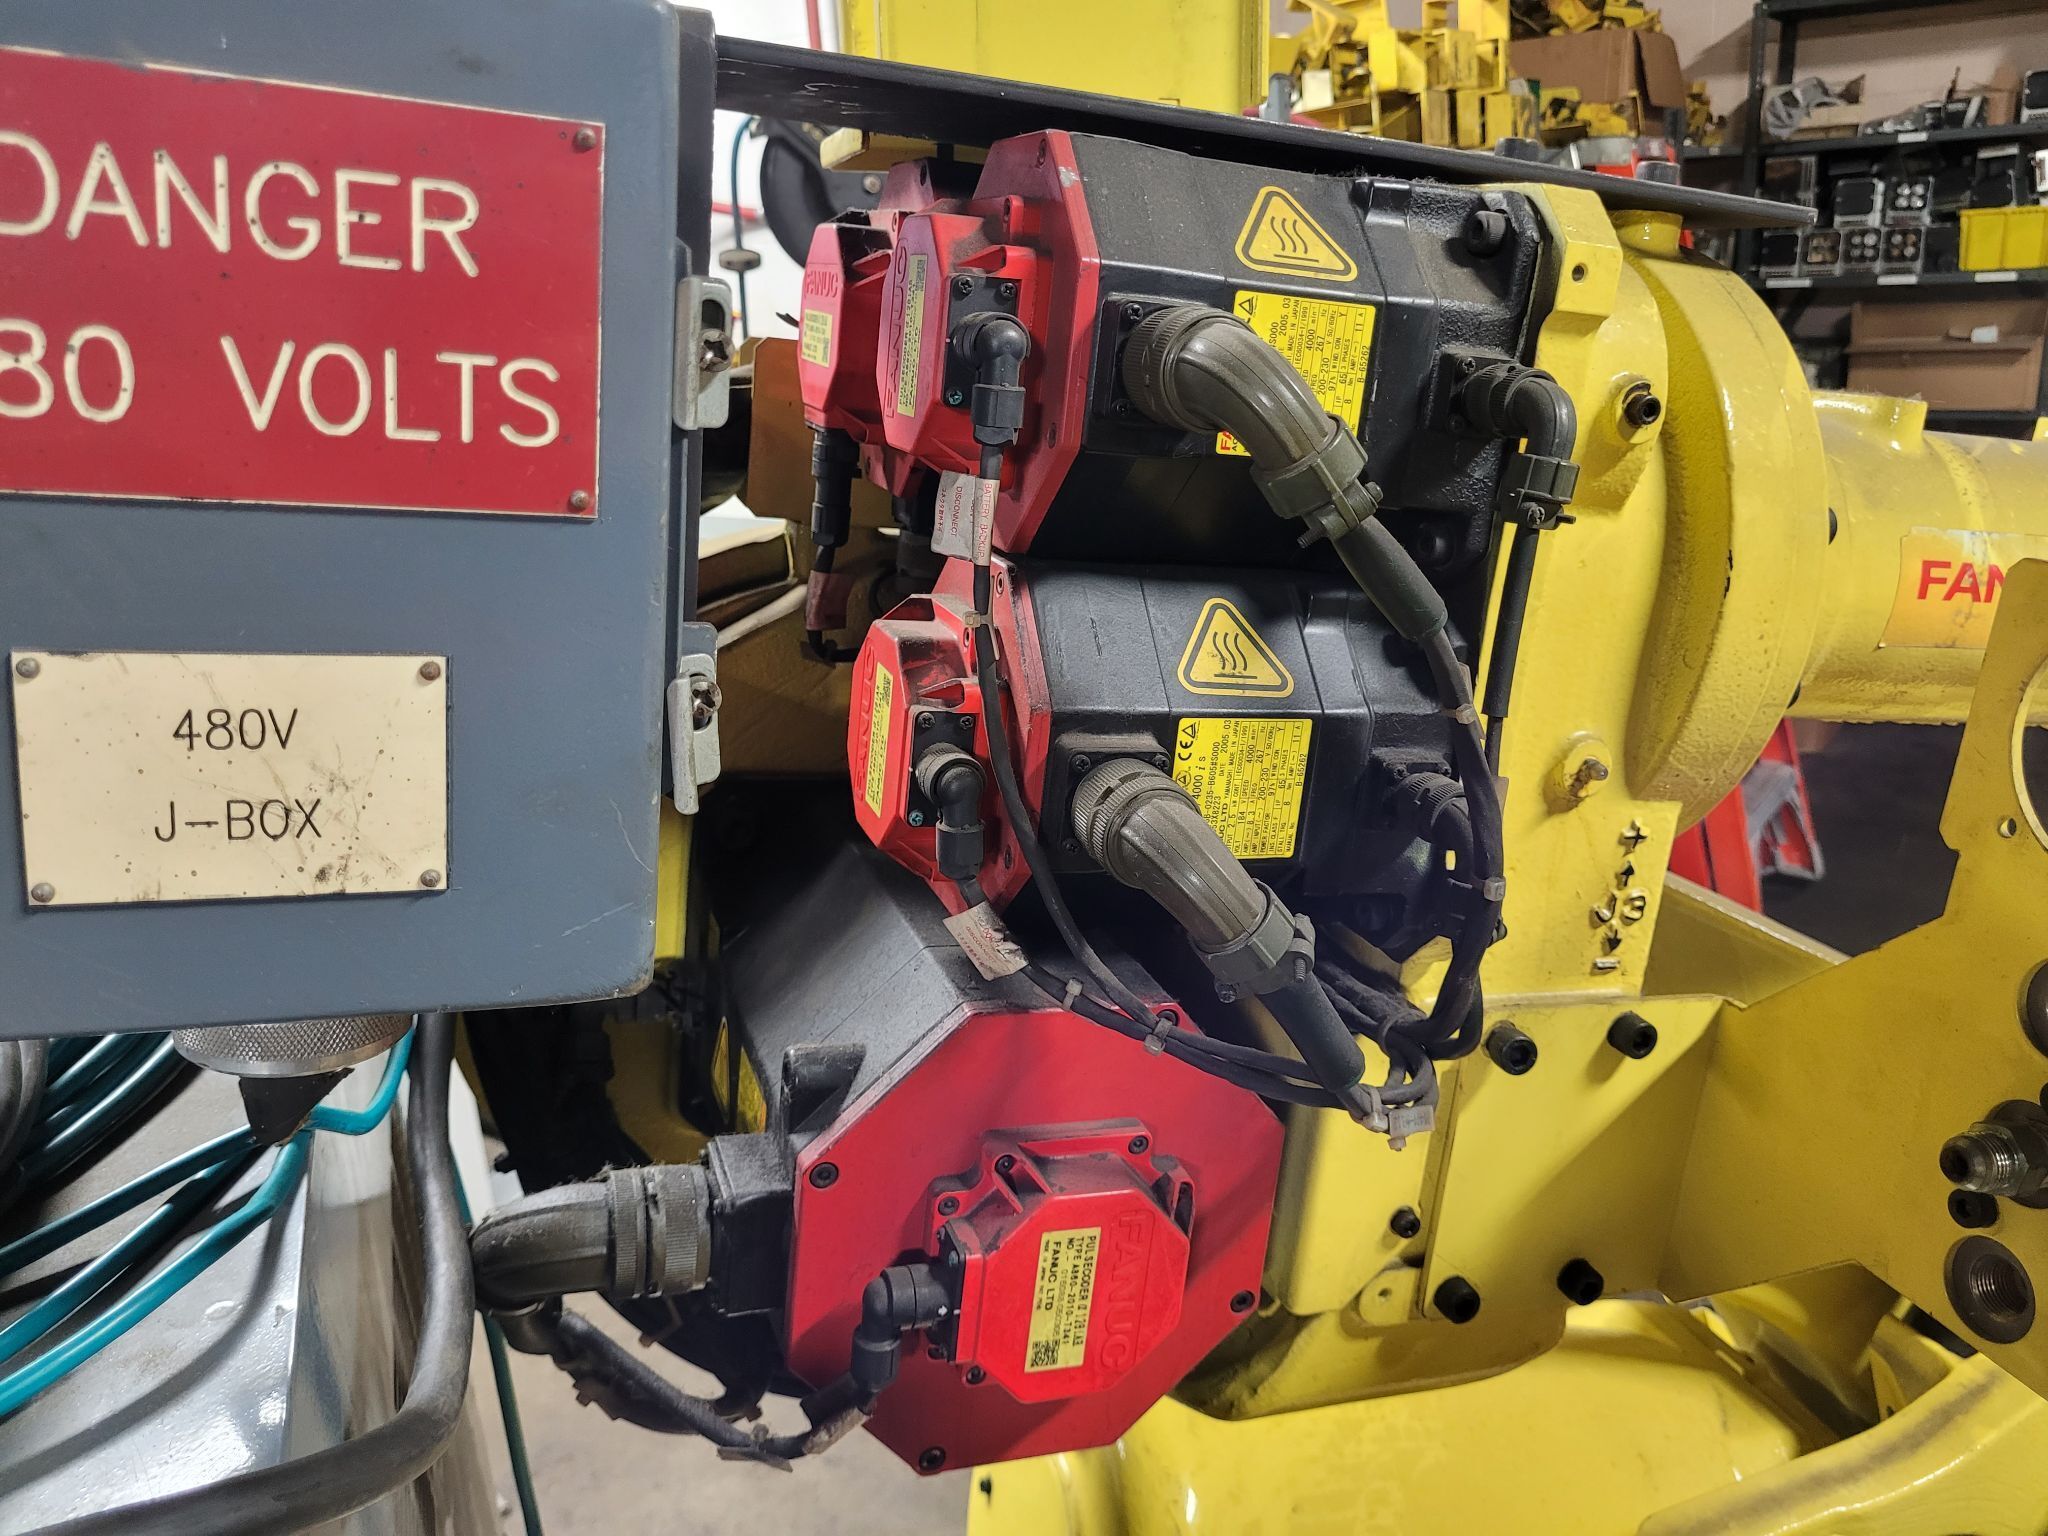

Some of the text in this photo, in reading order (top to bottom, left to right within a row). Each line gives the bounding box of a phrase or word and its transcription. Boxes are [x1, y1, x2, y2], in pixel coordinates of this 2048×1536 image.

[1305, 329, 1315, 351] 4000
[1316, 335, 1325, 352] 267
[1318, 357, 1329, 395] 200-230
[1339, 373, 1348, 384] 65
[1357, 345, 1369, 383] B-65262
[220, 334, 560, 447] VOLTS
[951, 486, 963, 537] DISCONNECT
[981, 483, 993, 519] BATTERY
[173, 706, 299, 751] 480V
[1221, 719, 1231, 754] 2005.03
[1232, 720, 1240, 737] JAPAN
[1238, 811, 1246, 825] 184
[1246, 744, 1255, 764] 4000
[1247, 811, 1255, 825] 8.3
[1256, 749, 1264, 764] 267
[1258, 767, 1269, 800] 200-230
[1278, 779, 1285, 789] 65
[154, 797, 323, 843] J-BOX
[1285, 833, 1294, 852] MANUAL
[1296, 753, 1306, 787] B-65262
[1228, 814, 1236, 828] 2.5
[1263, 812, 1271, 833] FACTOR
[1260, 836, 1269, 853] POWER
[1048, 1241, 1061, 1283] FANUC
[1073, 1237, 1084, 1260] TYPE
[1079, 1236, 1096, 1300] PULSECODER
[1045, 1288, 1055, 1311] LTD
[1100, 1215, 1145, 1370] FANUC
